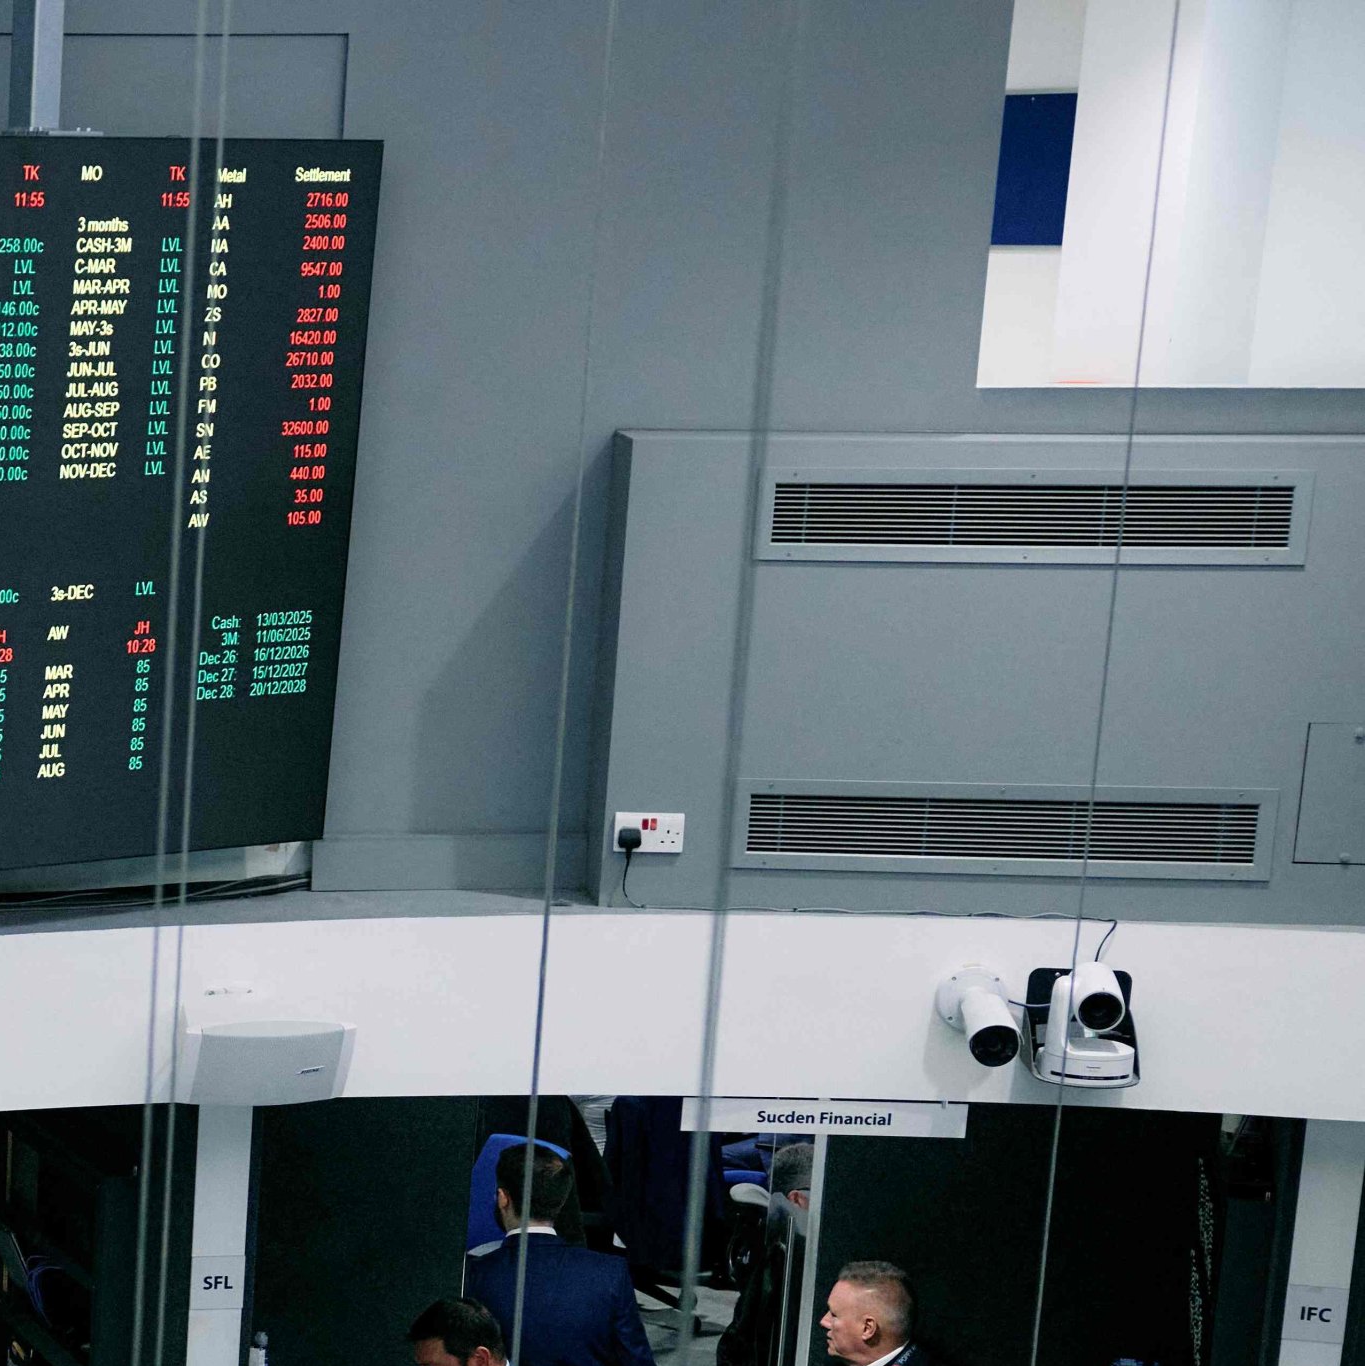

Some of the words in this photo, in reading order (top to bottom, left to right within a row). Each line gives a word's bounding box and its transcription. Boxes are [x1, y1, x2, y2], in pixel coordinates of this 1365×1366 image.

[23, 165, 40, 180] TK
[81, 165, 103, 181] MO
[169, 165, 185, 181] TK
[217, 168, 247, 183] Metal
[295, 167, 351, 182] Settlement
[15, 192, 44, 207] 11:55
[161, 192, 190, 208] 11:55
[214, 194, 232, 208] AH
[307, 193, 348, 207] 2716.00
[212, 217, 230, 231] AA
[305, 214, 346, 229] 2506.00
[210, 239, 228, 253] NA
[303, 236, 345, 250] 2400.00
[209, 262, 226, 276] CA
[301, 262, 342, 276] 9547.00
[207, 285, 227, 299] MO
[319, 285, 340, 298] 1.00
[204, 307, 221, 322] ZS
[297, 308, 338, 323] 2827.00
[202, 331, 216, 346] NI
[290, 330, 336, 345] 16420.00
[201, 354, 220, 369] CO
[286, 351, 334, 366] 26710.00
[212, 615, 241, 629] Cash:
[257, 610, 312, 626] 13/03/2025
[222, 632, 239, 646] 3M:
[257, 627, 310, 643] 11/06/2025
[199, 650, 221, 666] Dec
[222, 649, 238, 664] 26:
[254, 645, 309, 661] 16/12/2026
[198, 669, 219, 683] Dec
[221, 667, 237, 682] 27:
[253, 662, 308, 679] 15/12/2027
[196, 686, 218, 701] Dec
[250, 679, 306, 696] 20/12/2028
[757, 1110, 815, 1124] Sucden
[819, 1112, 892, 1126] Financial
[203, 1275, 234, 1290] SFL
[1300, 1306, 1332, 1323] IFC
